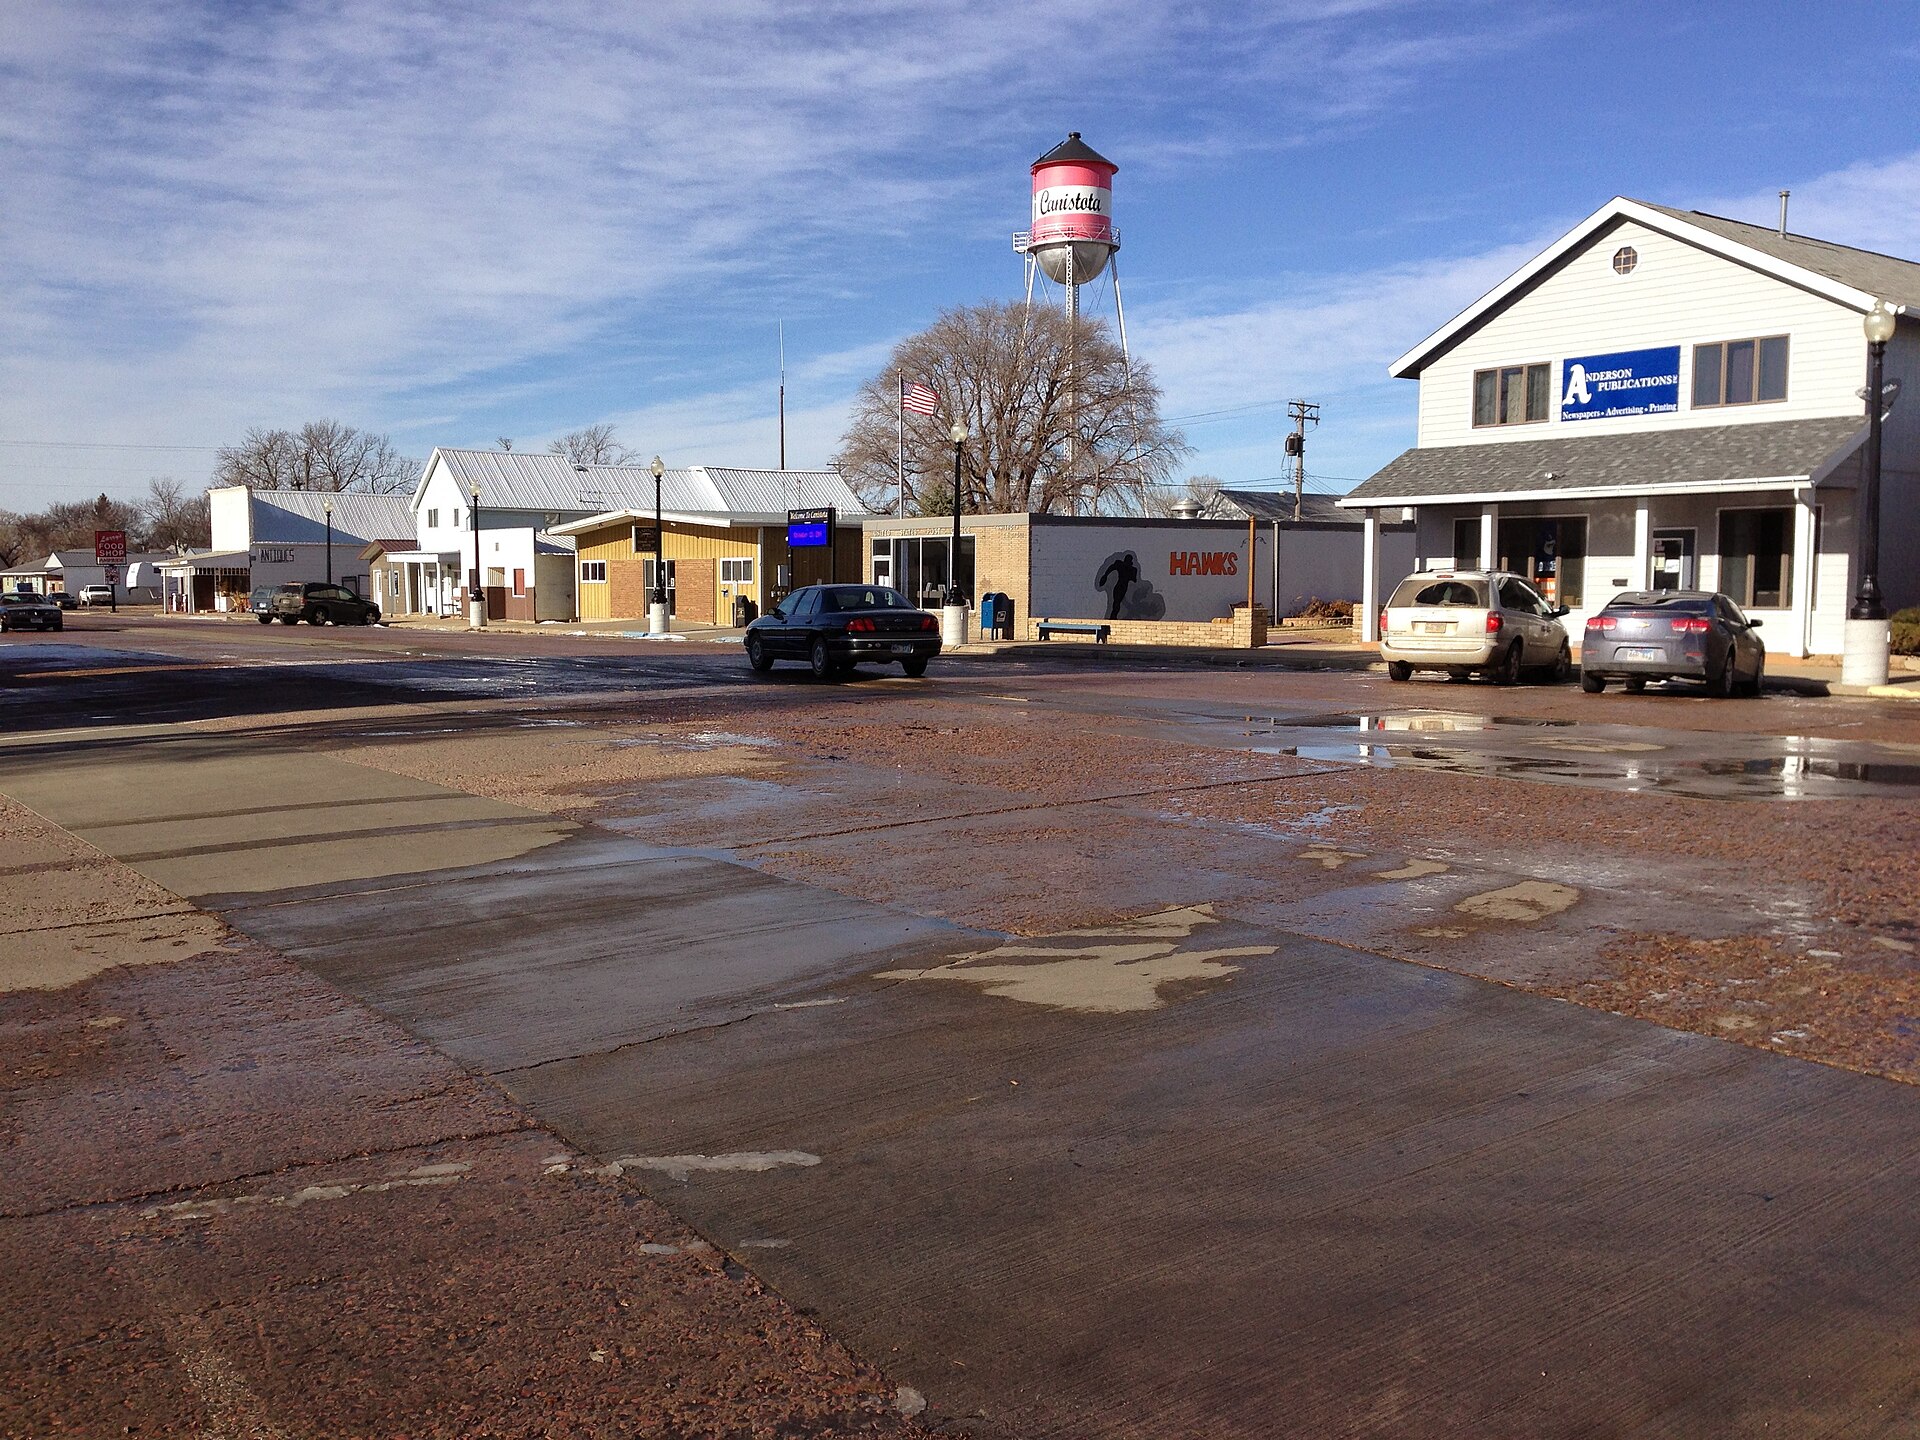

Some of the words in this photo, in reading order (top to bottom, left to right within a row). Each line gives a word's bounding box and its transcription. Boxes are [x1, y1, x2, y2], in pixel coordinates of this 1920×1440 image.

[1040, 190, 1102, 215] Canistota
[1562, 363, 1632, 406] ANDERSON
[1598, 375, 1673, 392] PUBLICATIONS
[1563, 410, 1600, 420] Newspapers
[1605, 407, 1644, 417] Advertising
[1649, 402, 1677, 412] Printing
[261, 548, 294, 563] ANTIQUES
[1170, 551, 1238, 576] HAWKS
